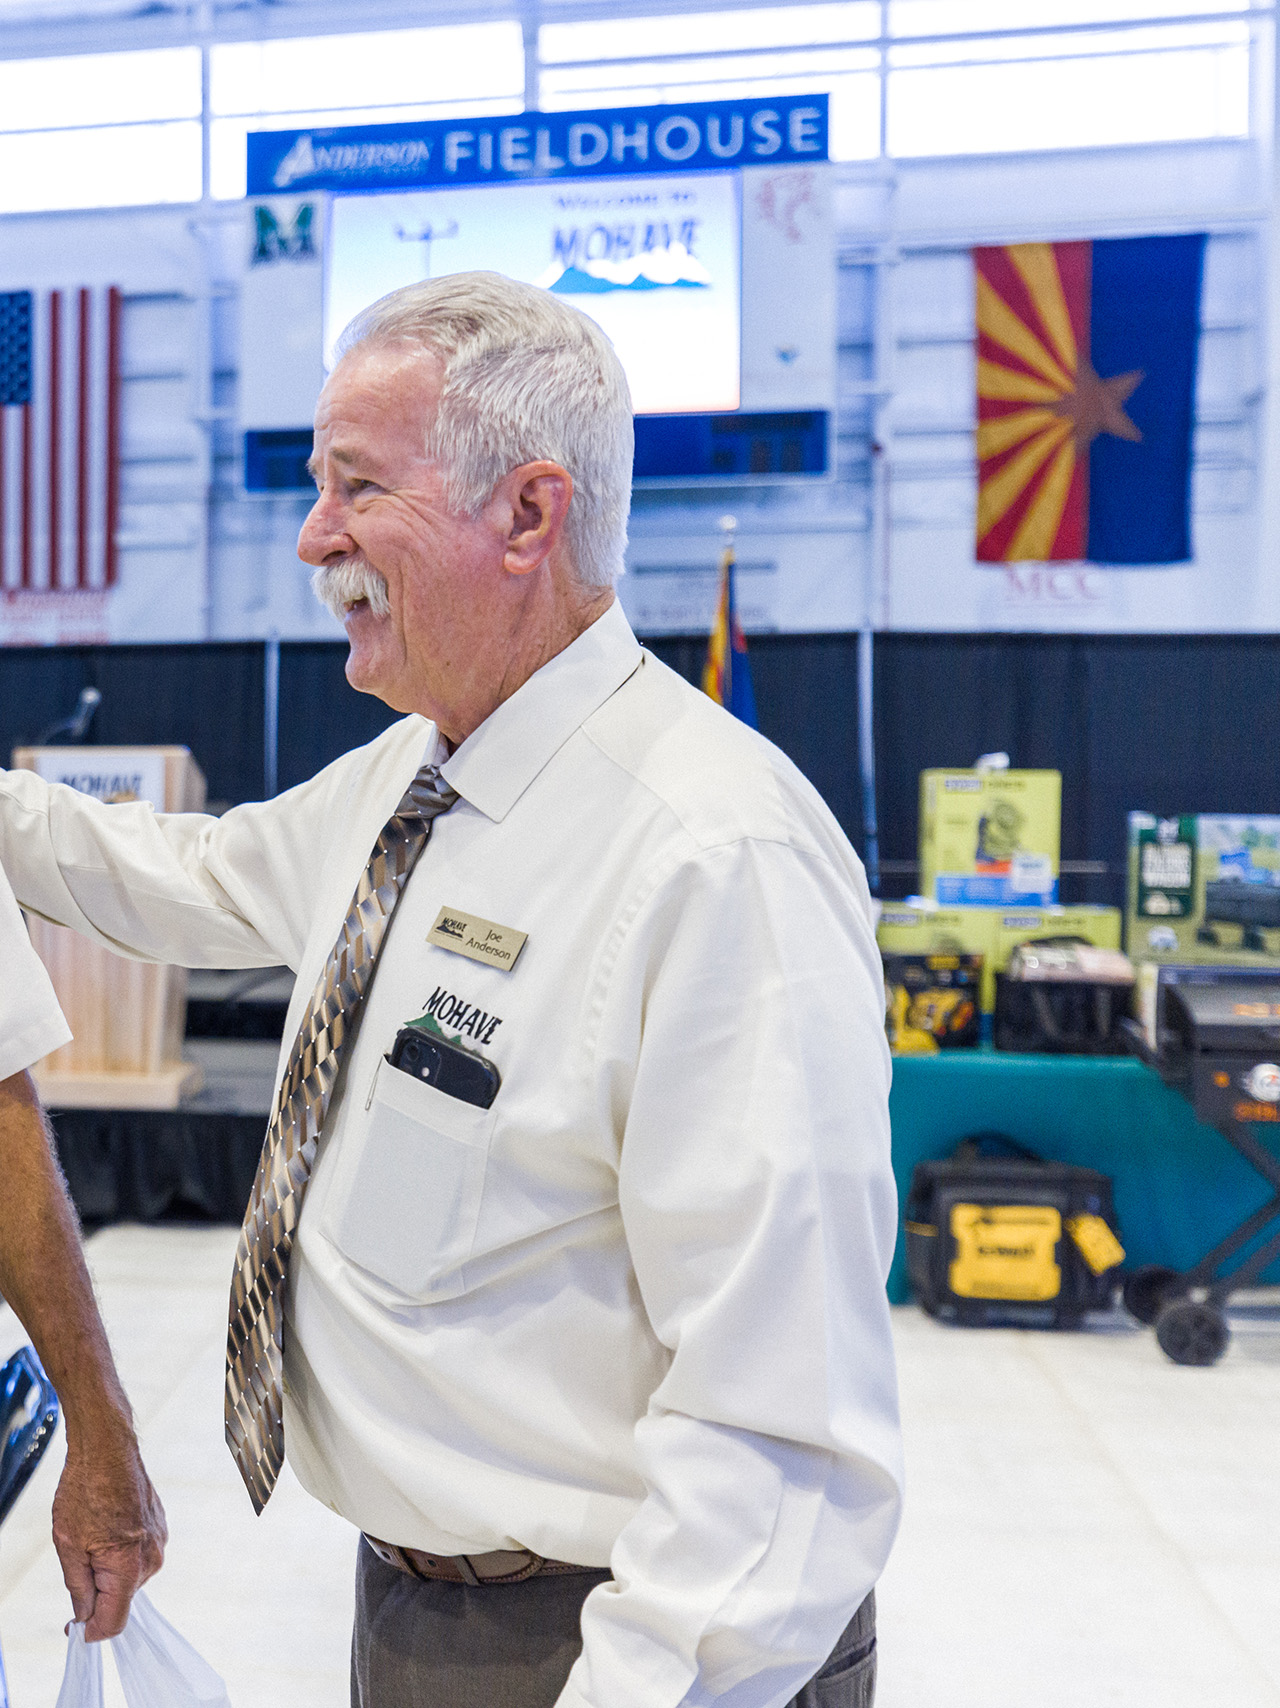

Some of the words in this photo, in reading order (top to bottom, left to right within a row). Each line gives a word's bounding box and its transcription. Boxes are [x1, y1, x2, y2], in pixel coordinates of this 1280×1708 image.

[443, 106, 822, 174] FIELDHOUSE
[552, 216, 699, 268] MOHAVE
[443, 917, 467, 932] MOHAVE
[485, 929, 503, 942] Joe
[465, 937, 512, 961] Anderson
[422, 986, 503, 1045] MOHAVE
